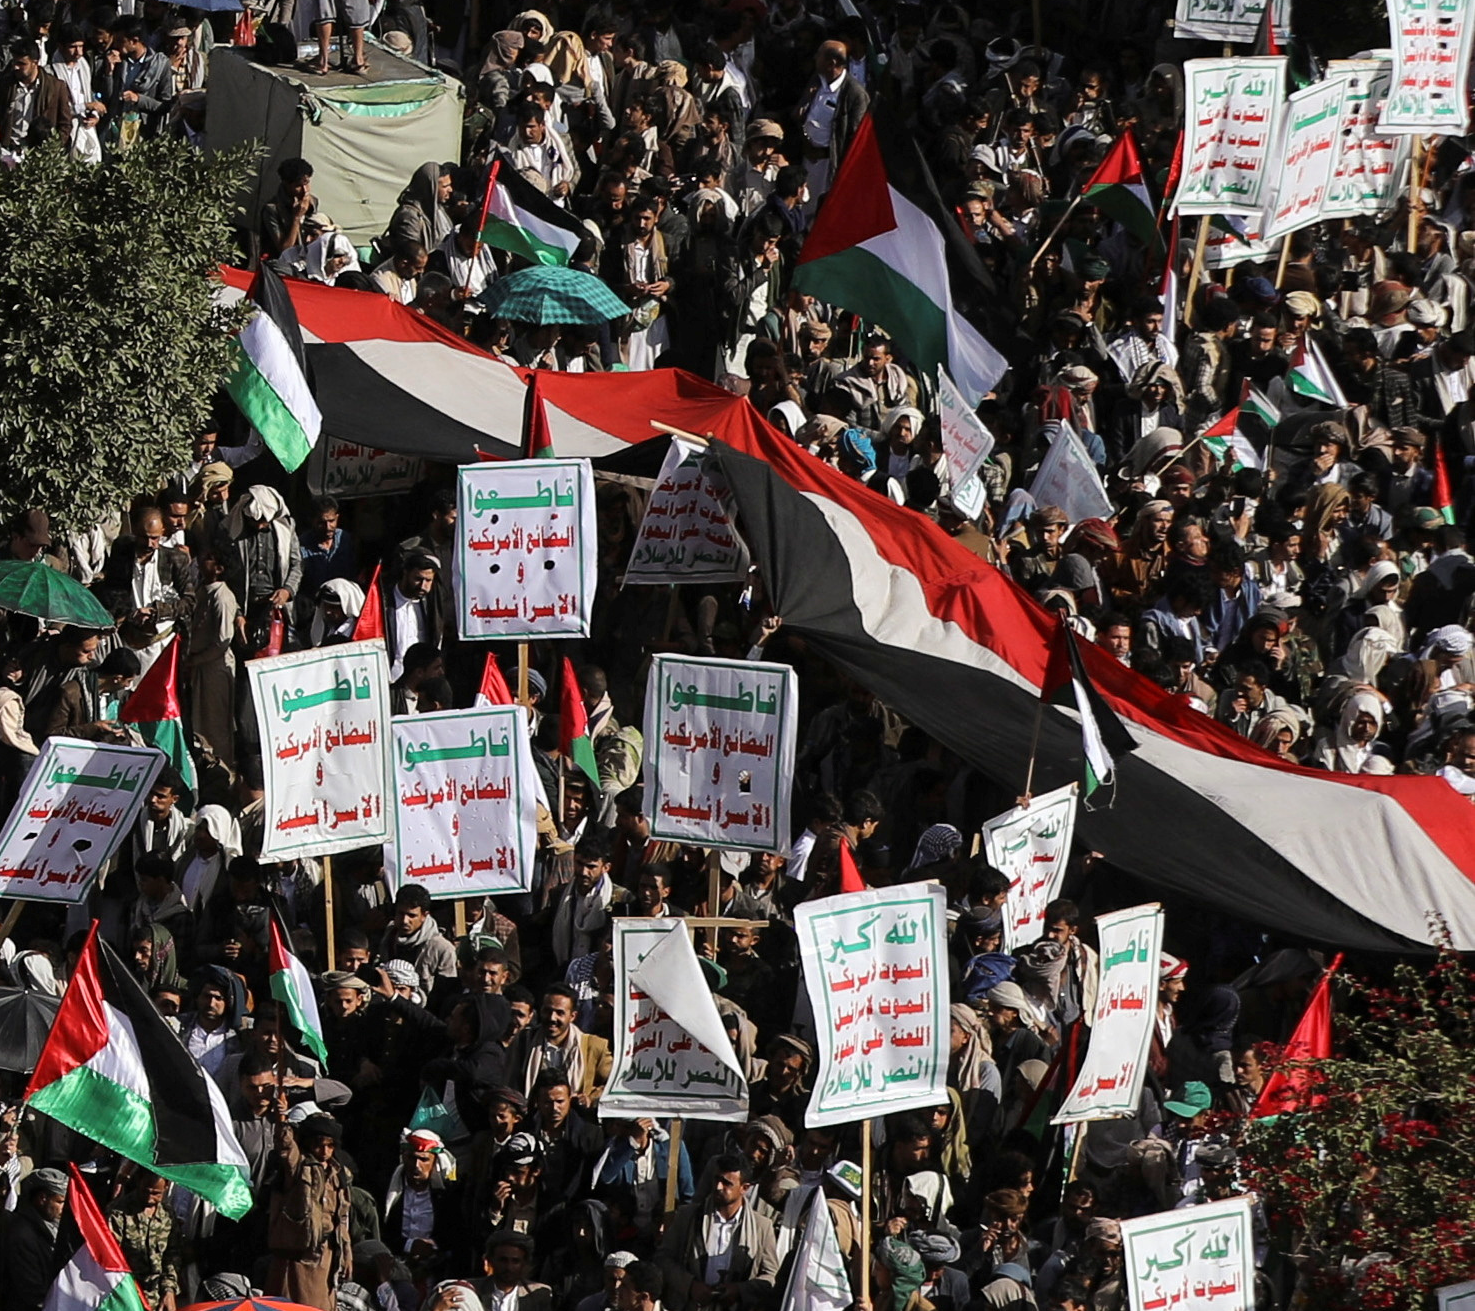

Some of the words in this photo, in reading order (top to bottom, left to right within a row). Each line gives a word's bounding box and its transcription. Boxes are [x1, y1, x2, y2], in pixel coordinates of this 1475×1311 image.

[468, 478, 574, 517] قاطعوا
[468, 523, 524, 556] الأمريكية
[527, 522, 575, 555] البضائع
[470, 593, 577, 624] الإسرائيلية
[273, 666, 371, 722] قاطعوا
[665, 673, 776, 716] قاطعوا
[275, 724, 322, 764] الأمريكية
[324, 717, 377, 758] البضائع
[398, 725, 509, 772] قاطعوا
[663, 719, 722, 755] الأمريكية
[723, 727, 773, 761] البضائع
[44, 755, 142, 792] قاطعوا
[460, 775, 511, 808] البضائع
[28, 796, 79, 821] الأمريكية
[400, 776, 458, 812] الأمريكية
[72, 800, 124, 828] البضائع
[275, 794, 380, 837] الإسرائيلية
[661, 793, 770, 833] الإسرائيلية
[405, 846, 516, 882] الإسرائيلية
[827, 909, 881, 966] أكبر
[883, 915, 928, 946] الله
[879, 958, 929, 981] الموت
[879, 993, 930, 1016] الموت
[835, 1039, 859, 1063] اليهود
[891, 1026, 930, 1048] اللعنة
[878, 1056, 930, 1092] النصر
[1141, 1230, 1195, 1280] أكبر
[1199, 1227, 1239, 1260] الله
[1194, 1274, 1241, 1297] الموت
